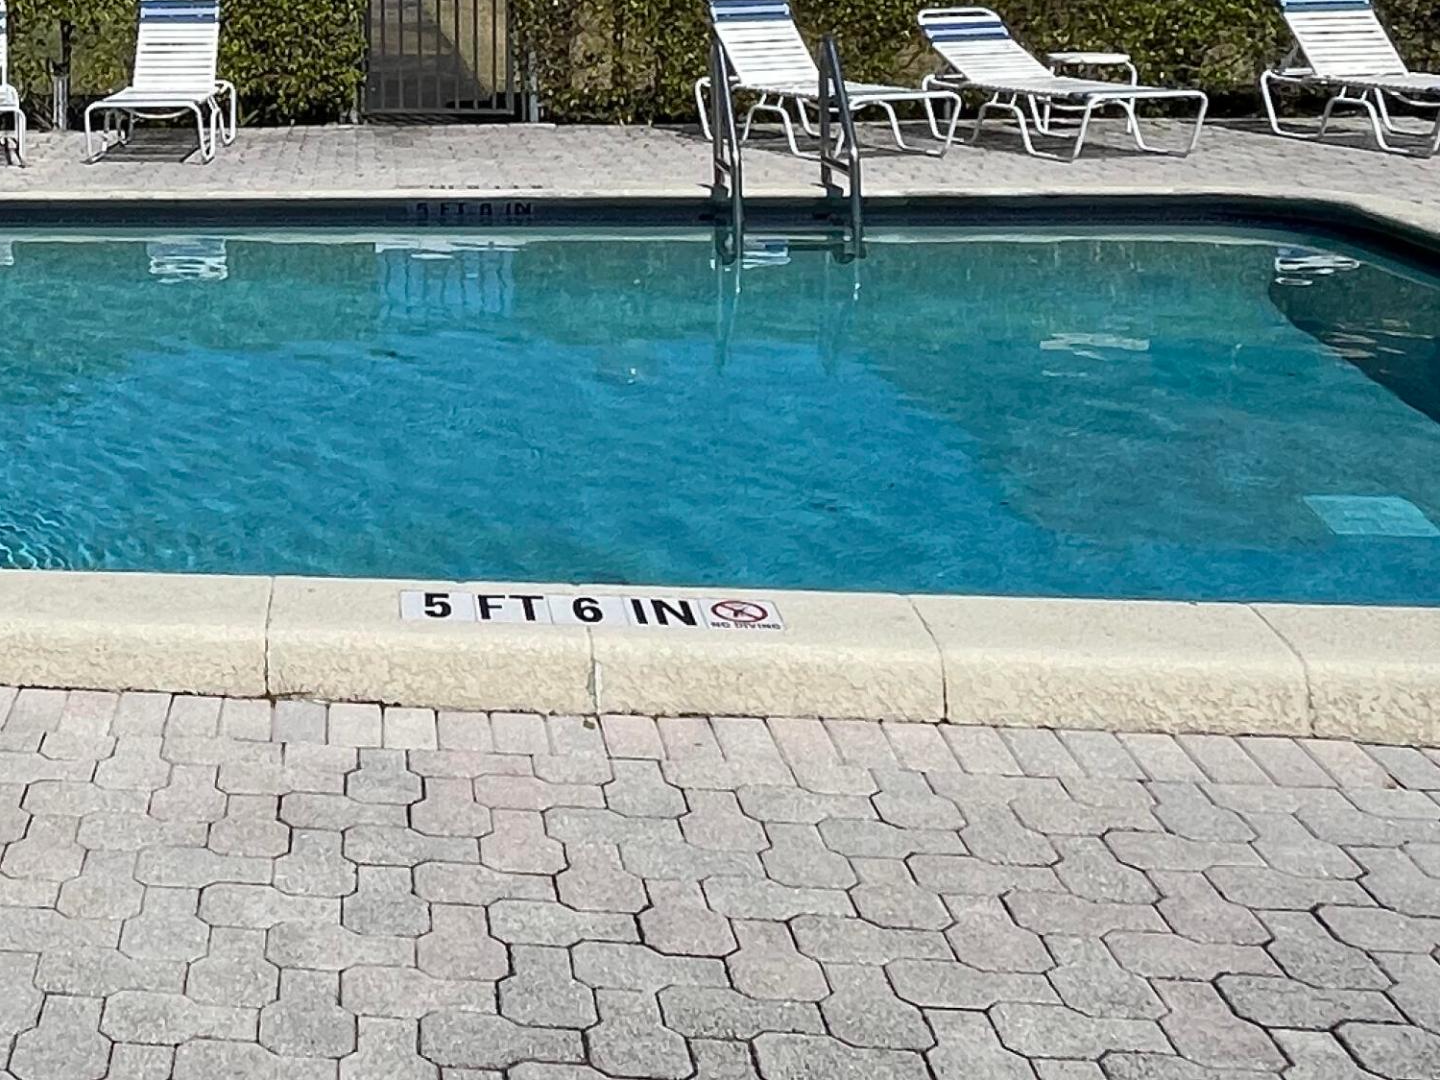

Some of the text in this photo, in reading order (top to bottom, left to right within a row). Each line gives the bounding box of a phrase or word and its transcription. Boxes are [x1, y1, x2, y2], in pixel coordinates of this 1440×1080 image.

[505, 202, 532, 216] IN
[423, 592, 698, 626] 5 FT 6 IN
